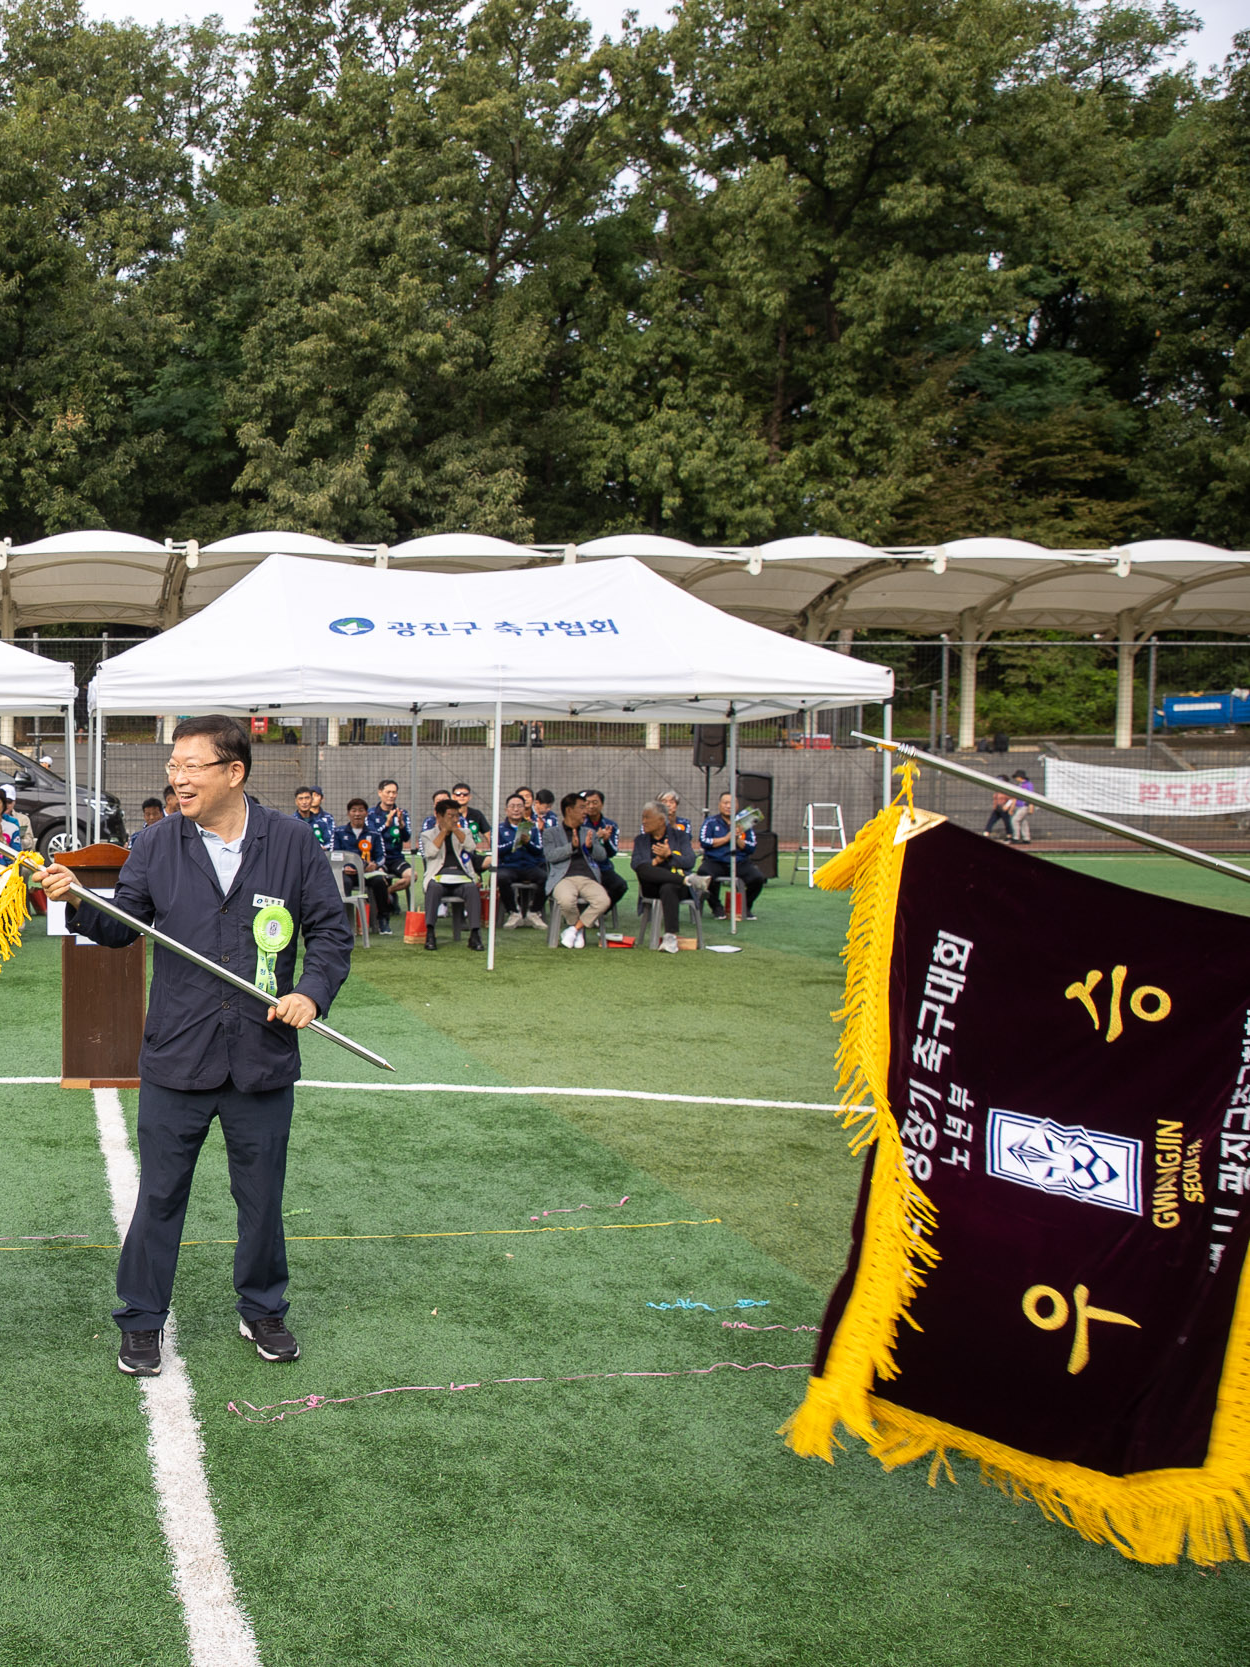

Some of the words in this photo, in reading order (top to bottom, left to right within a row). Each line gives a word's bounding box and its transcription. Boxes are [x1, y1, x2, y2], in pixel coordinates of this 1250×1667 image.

[386, 620, 482, 637] 광진구
[493, 618, 619, 637] 축구협회
[911, 929, 974, 1074] 축구대회
[1152, 1118, 1184, 1230] GWANGJIN
